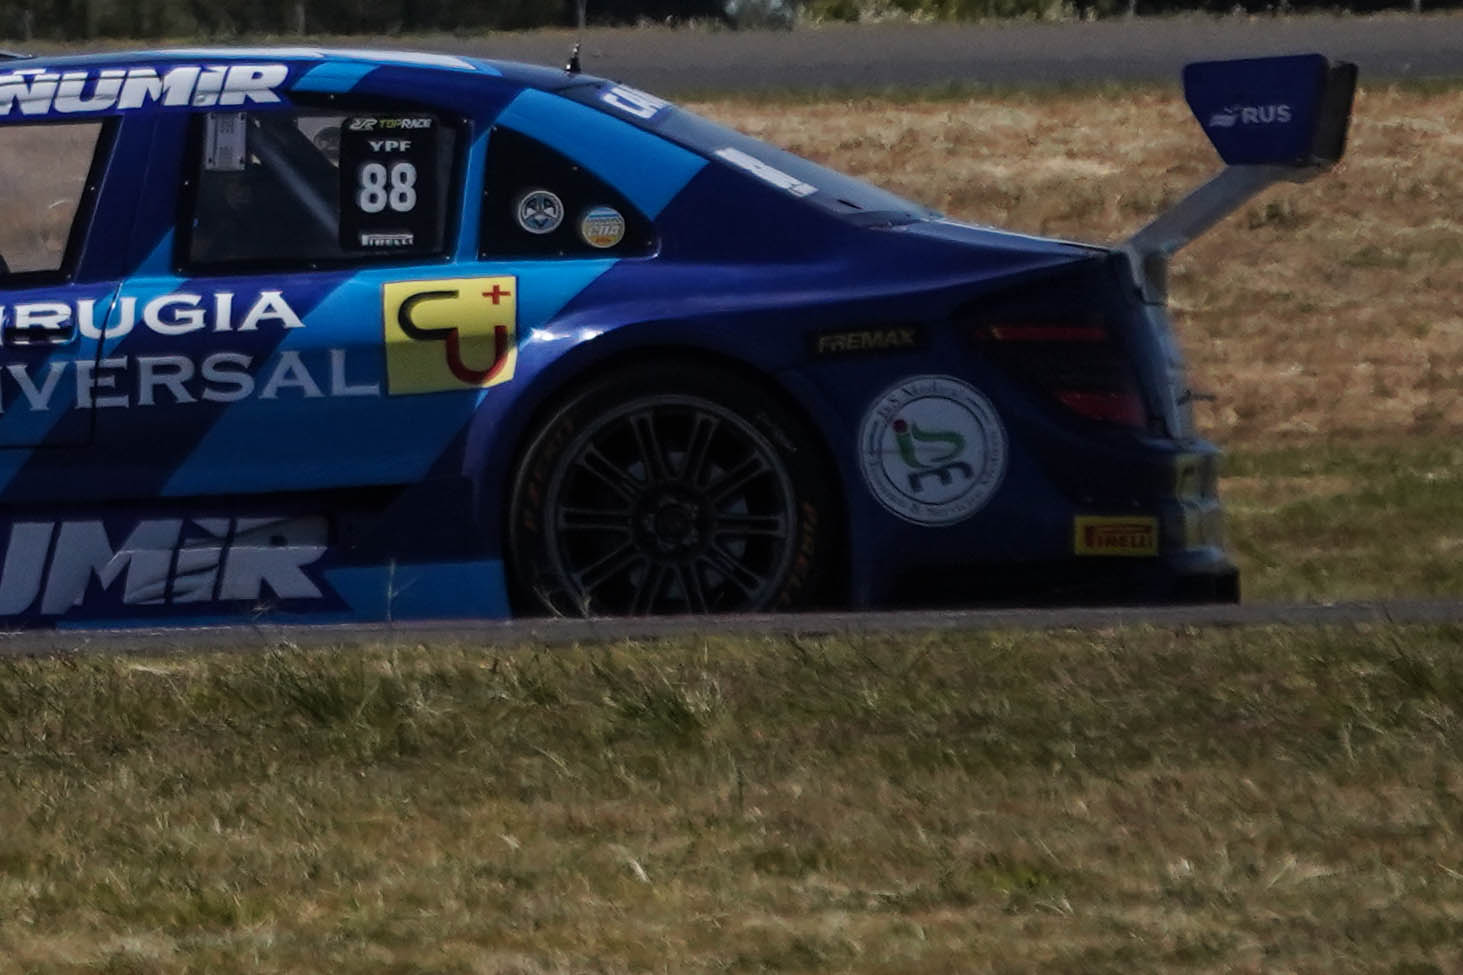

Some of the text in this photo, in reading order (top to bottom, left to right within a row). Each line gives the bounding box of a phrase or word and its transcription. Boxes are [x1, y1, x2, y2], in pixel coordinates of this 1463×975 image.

[1241, 104, 1292, 124] RUS
[368, 140, 412, 153] YPF
[359, 162, 418, 214] 88
[817, 329, 915, 353] FREMAX
